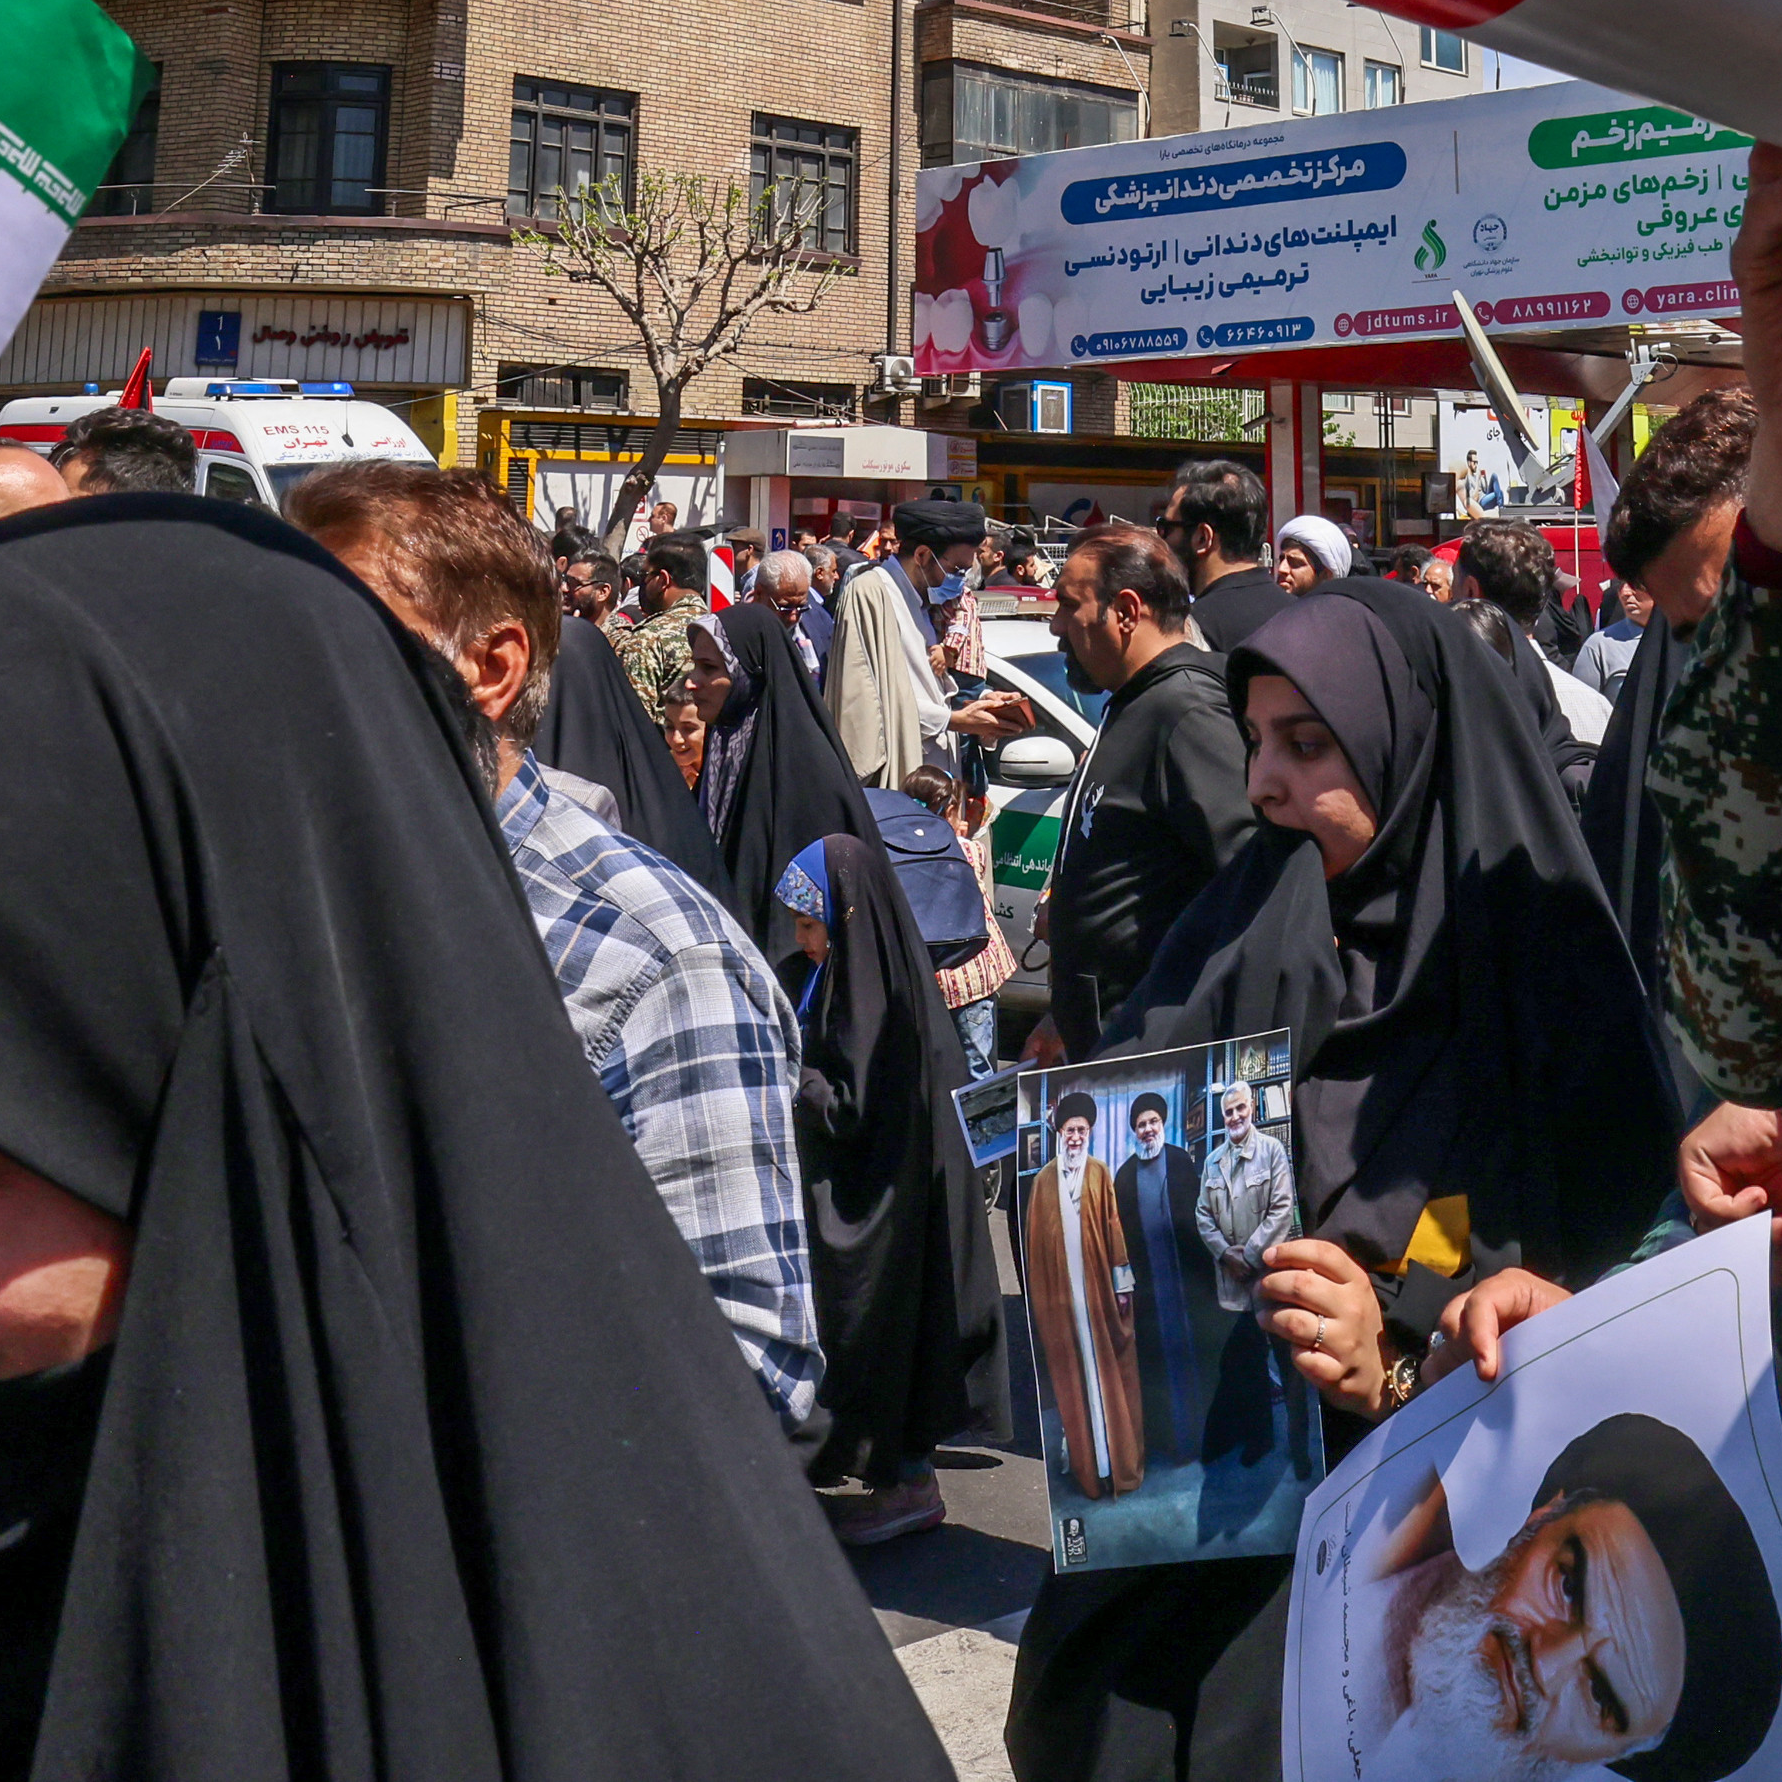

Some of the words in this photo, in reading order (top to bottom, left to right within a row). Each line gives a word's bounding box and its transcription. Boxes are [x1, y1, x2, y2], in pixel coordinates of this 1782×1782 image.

[1253, 134, 1285, 148] مجموعه
[1571, 118, 1635, 158] زخم
[1171, 144, 1203, 158] تخصصی
[1218, 160, 1314, 201] تخصصی
[1312, 154, 1366, 189] مرکز
[1095, 172, 1219, 214] دندانپزشکی
[1544, 182, 1607, 211] مزمن
[1637, 203, 1718, 236] عروقی
[1064, 239, 1168, 276] ارتودنسی
[1184, 232, 1262, 266] دندانی
[1577, 245, 1640, 268] توانبخشی
[1642, 247, 1650, 262] و
[1652, 238, 1694, 261] فیزیکی
[1697, 238, 1724, 255] طب
[1141, 273, 1214, 305] زیبایی
[1219, 261, 1310, 298] ترمیمی
[1366, 309, 1450, 332] jdtums.ir
[1226, 323, 1302, 342] ۶۶۴۶۰۹۱۳
[263, 425, 300, 436] EMS
[304, 425, 330, 435] 115
[283, 437, 329, 449] تهران
[861, 458, 894, 474] موتورسیکلت
[895, 461, 911, 474] سکوی
